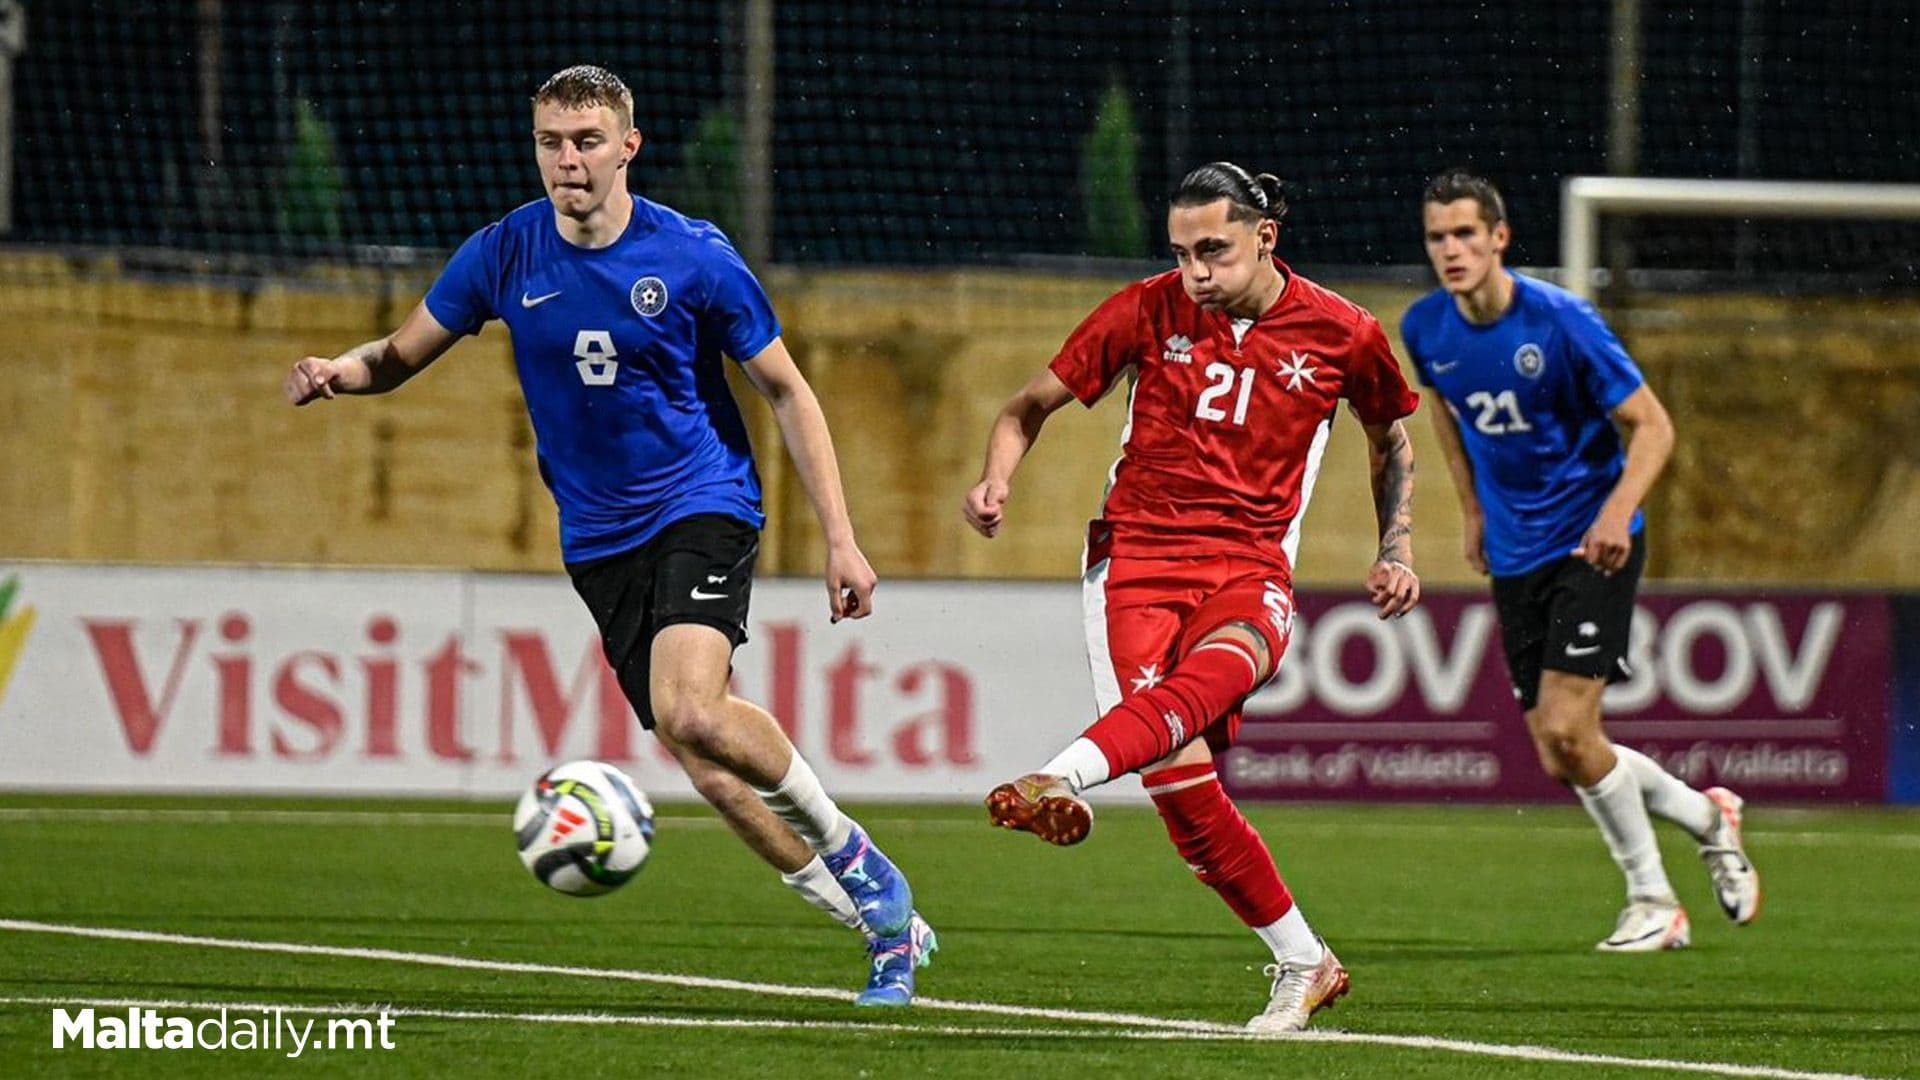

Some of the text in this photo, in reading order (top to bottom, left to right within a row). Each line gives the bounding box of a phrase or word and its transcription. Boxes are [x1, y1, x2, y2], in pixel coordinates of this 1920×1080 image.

[572, 329, 619, 387] 8
[1195, 361, 1256, 427] 21
[1465, 389, 1533, 435] 21
[81, 611, 980, 768] VisitMlta
